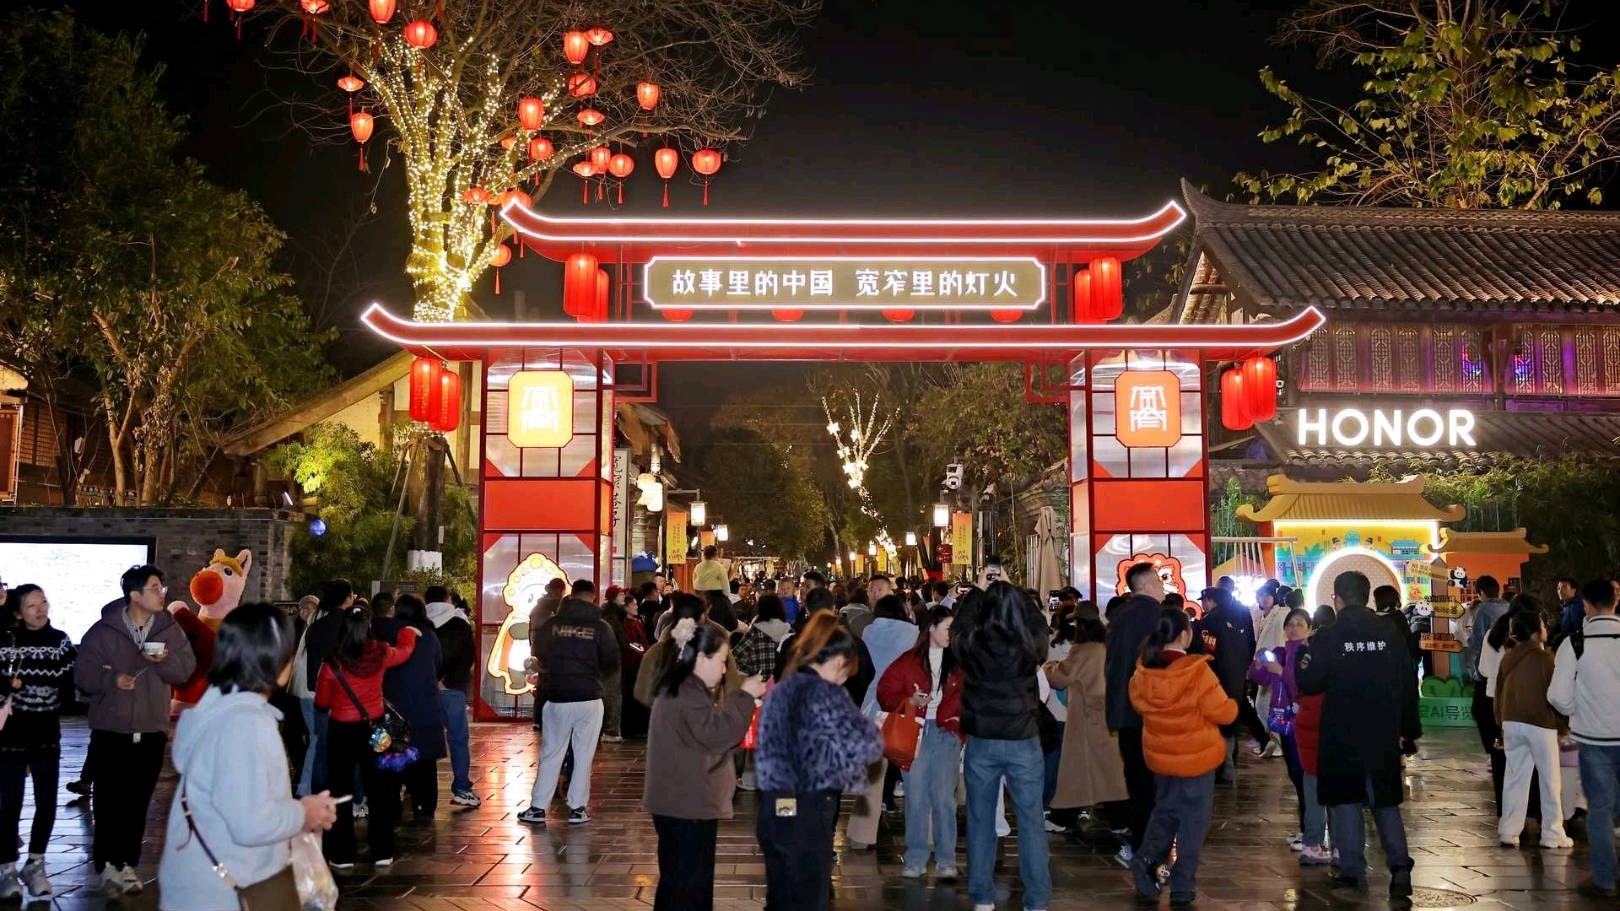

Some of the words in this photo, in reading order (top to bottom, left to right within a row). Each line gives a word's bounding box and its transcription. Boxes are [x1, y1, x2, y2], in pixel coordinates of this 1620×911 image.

[672, 269, 832, 296] 故事里的中国
[856, 269, 1018, 296] 宽窄里的灯火
[1298, 408, 1476, 445] HONOR
[552, 624, 594, 639] NIKE
[1344, 640, 1386, 652] 秩序维护
